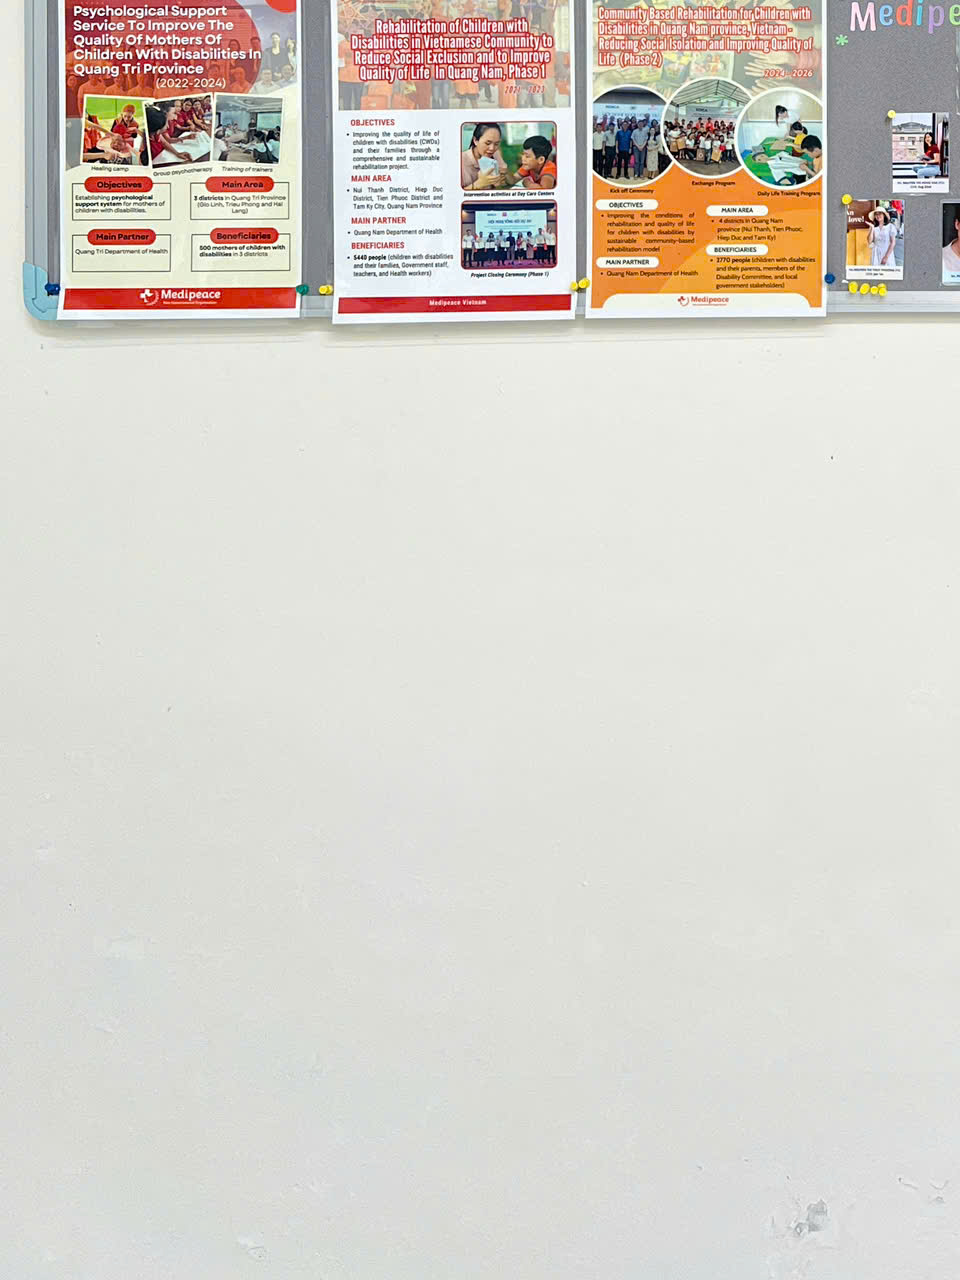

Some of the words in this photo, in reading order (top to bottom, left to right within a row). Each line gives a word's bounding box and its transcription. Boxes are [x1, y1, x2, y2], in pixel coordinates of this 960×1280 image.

[73, 6, 168, 18] Psychological
[171, 6, 227, 18] Support
[598, 7, 647, 22] Community
[650, 7, 675, 20] Based
[677, 7, 737, 20] Rehabilitation
[740, 7, 752, 20] for
[754, 7, 790, 20] Children
[792, 7, 811, 19] with
[73, 20, 124, 31] Service
[128, 20, 145, 30] To
[148, 20, 205, 32] Improve
[208, 20, 234, 30] The
[376, 20, 446, 34] Rehabilitation
[449, 19, 460, 34] of
[462, 19, 503, 33] Children
[506, 18, 528, 32] with
[598, 23, 648, 36] Disabilities
[650, 23, 658, 35] in
[660, 23, 687, 37] Quang
[689, 23, 708, 35] Nam
[710, 23, 749, 36] province,
[752, 23, 787, 35] Vietnam
[73, 34, 123, 48] Quality
[126, 34, 143, 45] Of
[146, 34, 202, 45] Mothers
[205, 34, 222, 45] Of
[351, 35, 409, 49] Disabilities
[411, 35, 421, 48] in
[423, 35, 482, 49] Vietnamese
[484, 34, 540, 50] Community
[542, 35, 553, 47] to
[598, 38, 639, 52] Reducing
[640, 38, 667, 50] Social
[669, 38, 707, 50] Isolation
[708, 38, 724, 50] and
[726, 38, 770, 53] Improving
[771, 37, 801, 52] Quality
[803, 37, 813, 50] of
[73, 49, 133, 60] Children
[136, 49, 168, 60] With
[171, 48, 246, 60] Disabilities
[249, 48, 262, 59] In
[355, 50, 391, 65] Reduce
[393, 50, 424, 64] Social
[427, 50, 474, 64] Exclusion
[477, 50, 494, 63] and
[496, 50, 507, 63] to
[510, 49, 550, 64] Improve
[73, 64, 120, 77] Quang
[122, 64, 141, 74] Tri
[144, 64, 204, 75] Province
[359, 66, 395, 83] Quality
[398, 66, 409, 80] of
[411, 66, 430, 80] Life
[435, 66, 445, 80] In
[447, 66, 478, 82] Quang
[482, 65, 506, 80] Nam,
[509, 65, 538, 79] Phase
[540, 65, 546, 78] 1
[156, 78, 226, 89] (2022-2024)
[372, 174, 392, 182] AREA
[97, 181, 142, 190] Objectives
[118, 233, 150, 241] Partner
[216, 232, 271, 240] Beneficiaries
[351, 242, 404, 250] BENEFICIARIES
[160, 289, 221, 300] Medipeace
[690, 296, 730, 304] Medipeace
[429, 299, 460, 307] Medipeace
